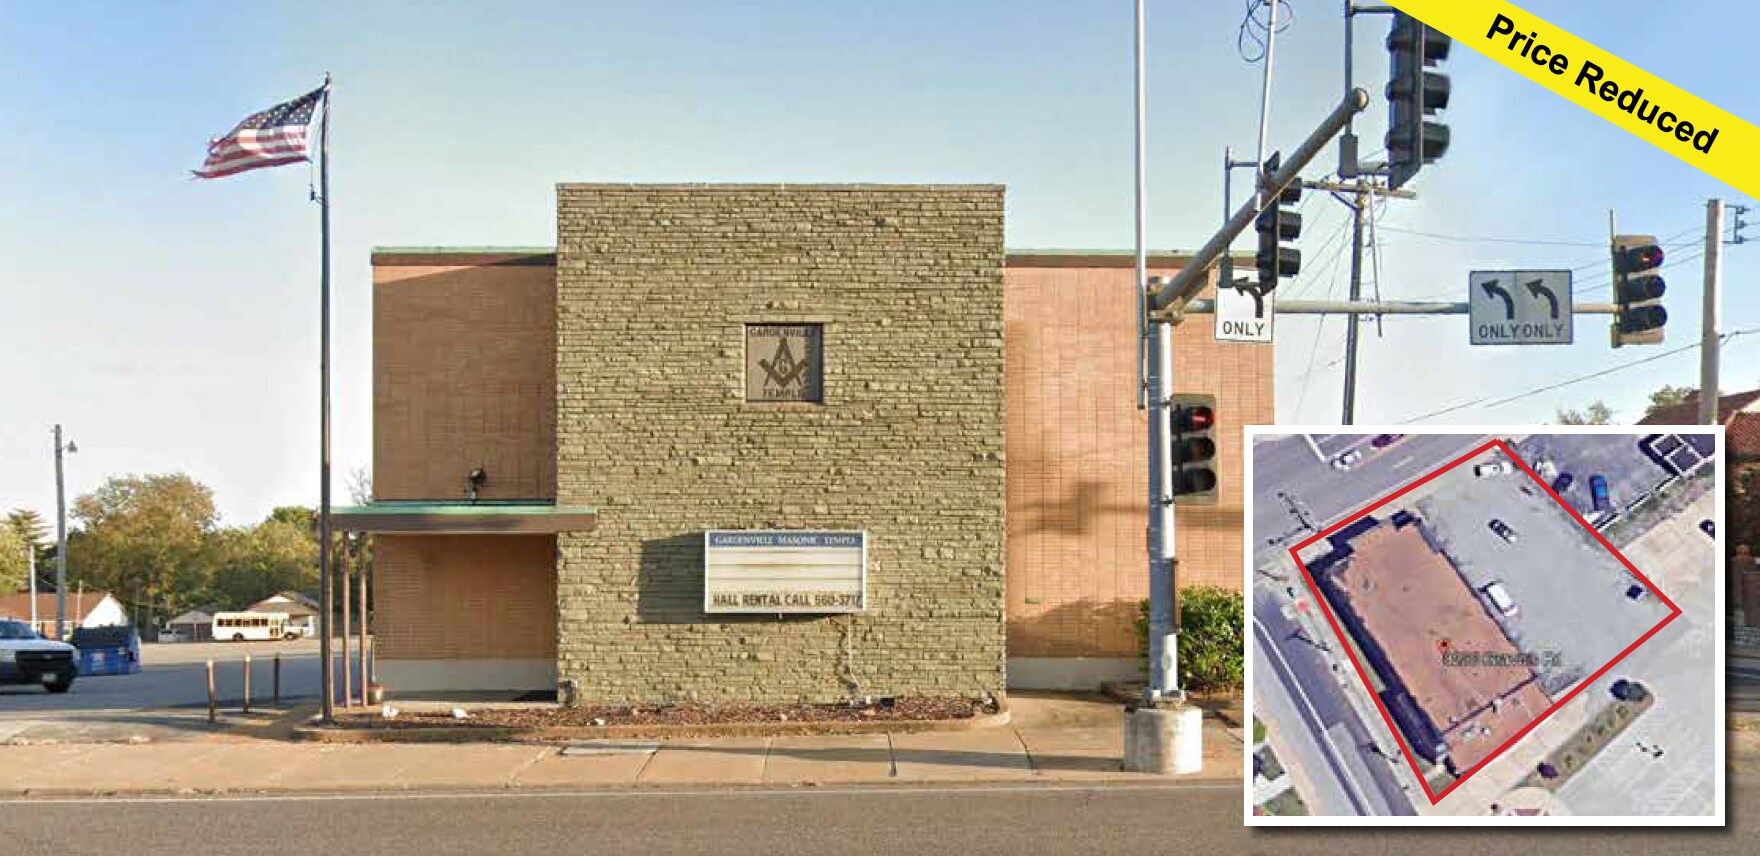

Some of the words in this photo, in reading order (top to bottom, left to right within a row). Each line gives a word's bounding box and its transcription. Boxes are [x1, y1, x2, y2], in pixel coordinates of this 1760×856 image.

[1223, 320, 1265, 337] ONLY
[1478, 323, 1519, 339] ONLY
[1522, 323, 1563, 338] ONLY
[714, 535, 774, 545] GARDENVILLE
[777, 535, 817, 545] MASONIC
[712, 594, 738, 607] HALL
[743, 594, 780, 607] RENTAL
[784, 594, 811, 607] CALL
